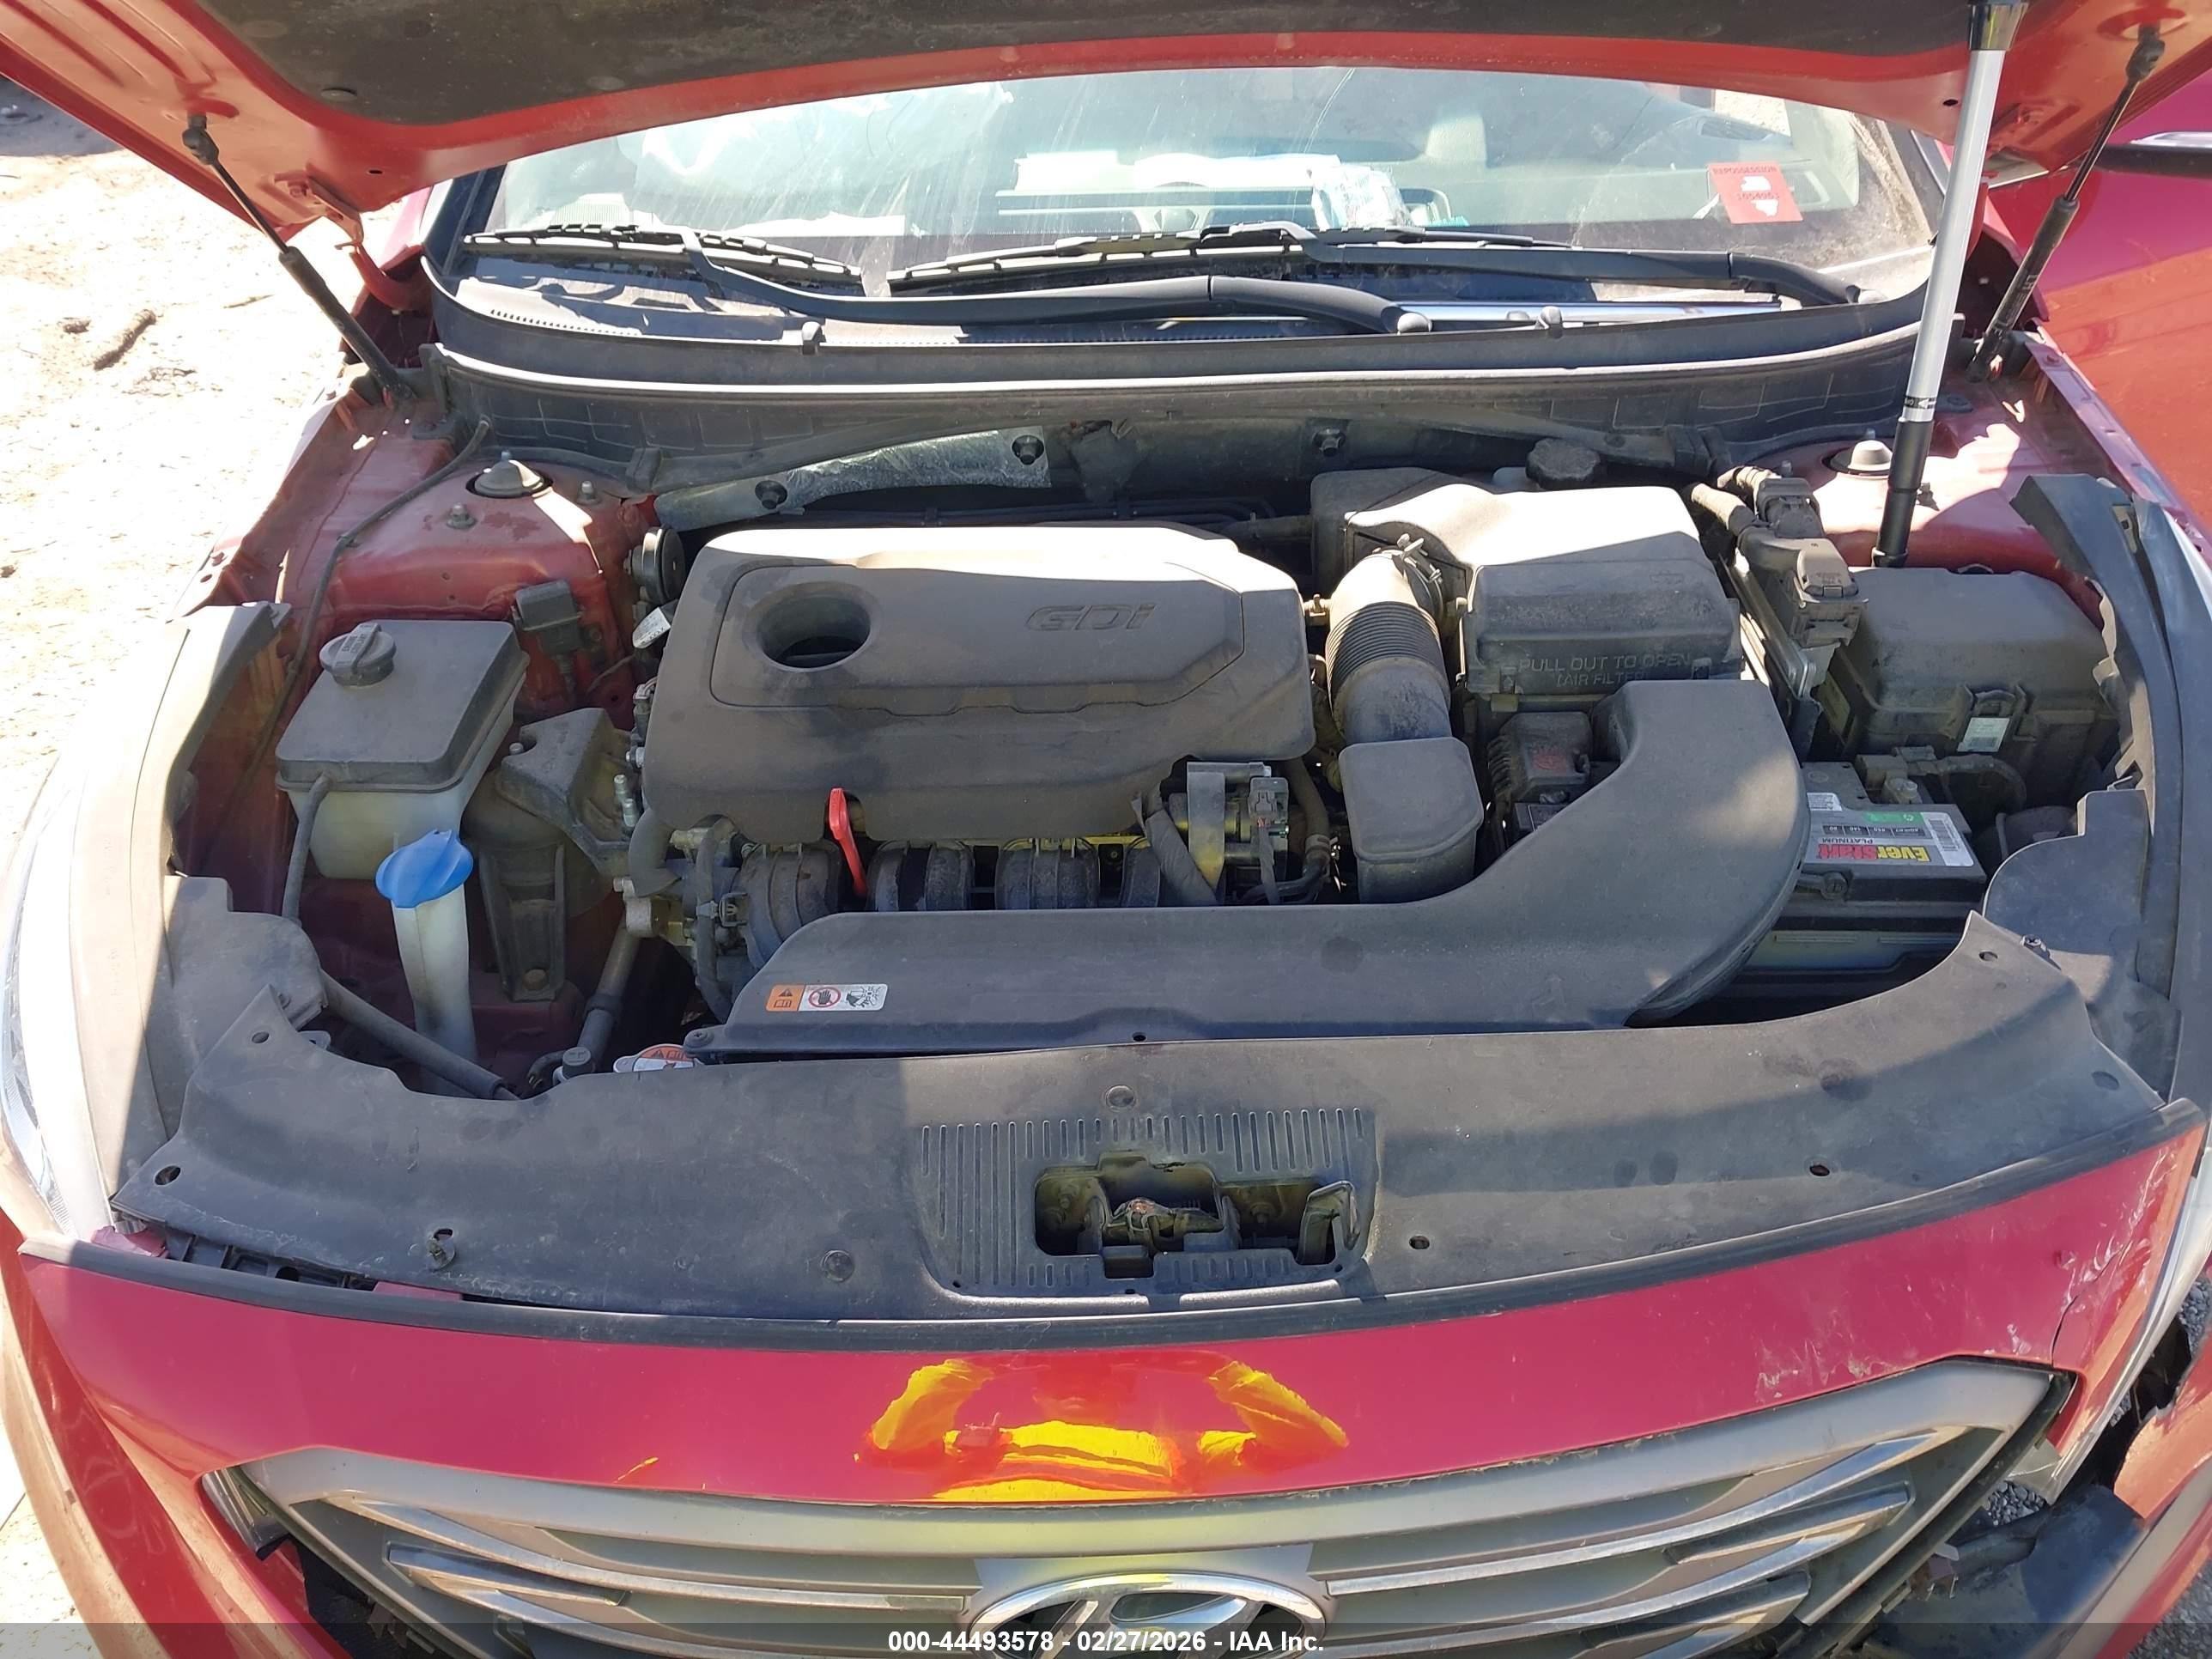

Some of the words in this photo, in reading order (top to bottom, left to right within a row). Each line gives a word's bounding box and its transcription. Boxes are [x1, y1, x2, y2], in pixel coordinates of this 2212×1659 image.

[1516, 657, 1566, 672] PULL
[1570, 656, 1608, 672] OUT
[1613, 654, 1638, 669] TO
[1642, 653, 1691, 667] OPEN
[1818, 843, 1931, 862] EverStart
